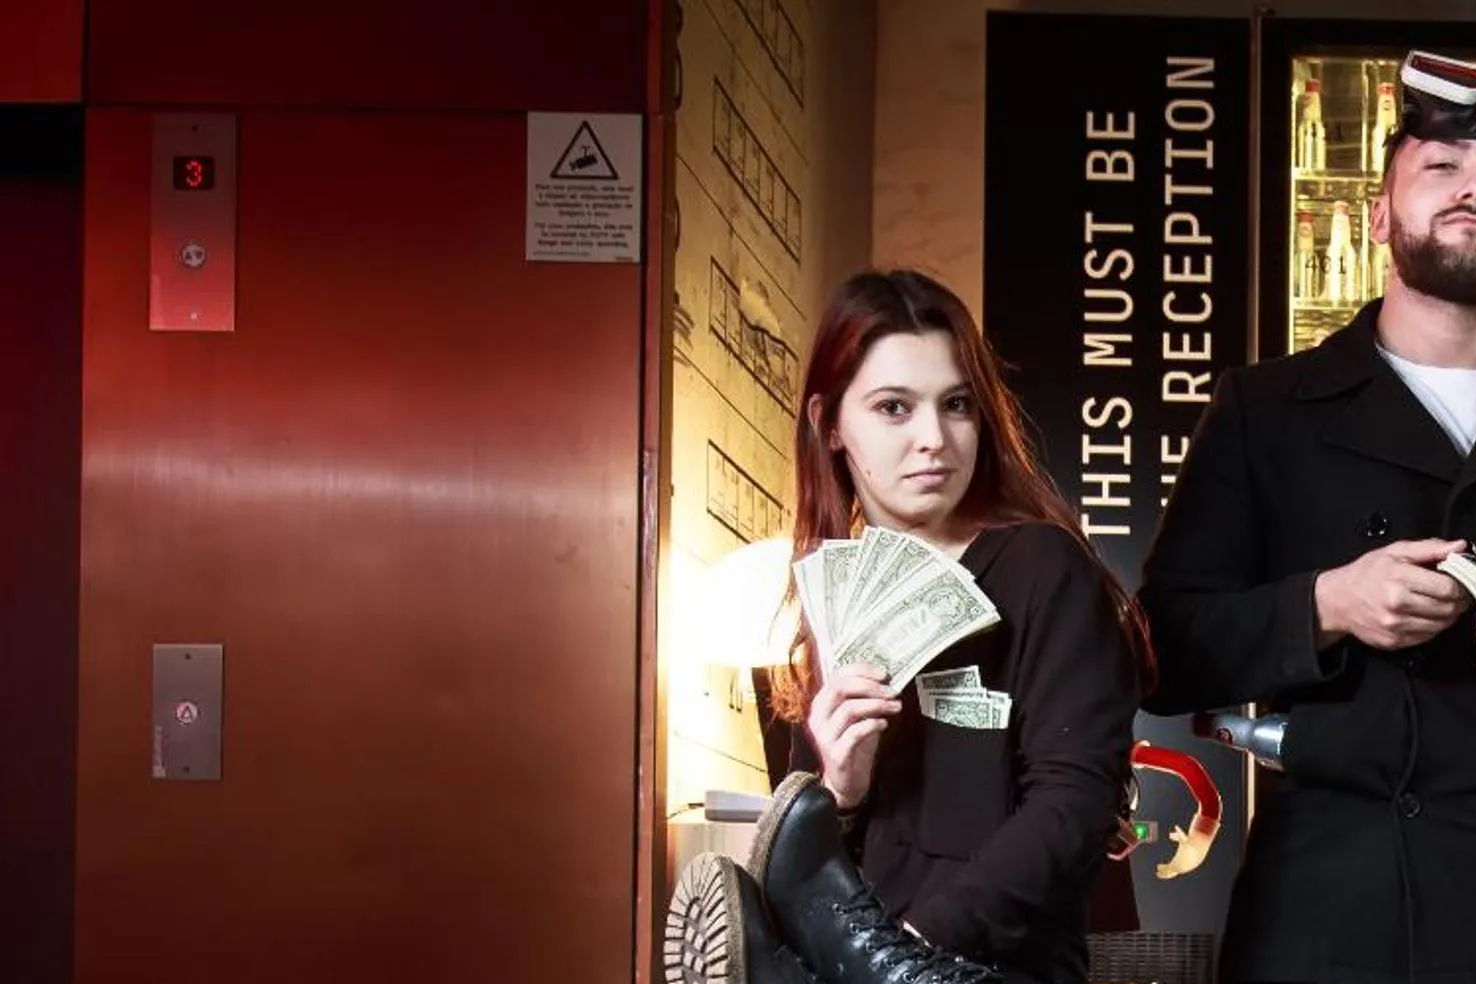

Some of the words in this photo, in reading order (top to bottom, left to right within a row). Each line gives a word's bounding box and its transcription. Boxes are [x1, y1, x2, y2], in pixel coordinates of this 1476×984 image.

[184, 160, 203, 188] 3
[1086, 110, 1135, 181] BE
[1083, 211, 1134, 366] MUST
[1161, 56, 1214, 403] RECEPTION
[1079, 396, 1133, 541] THIS
